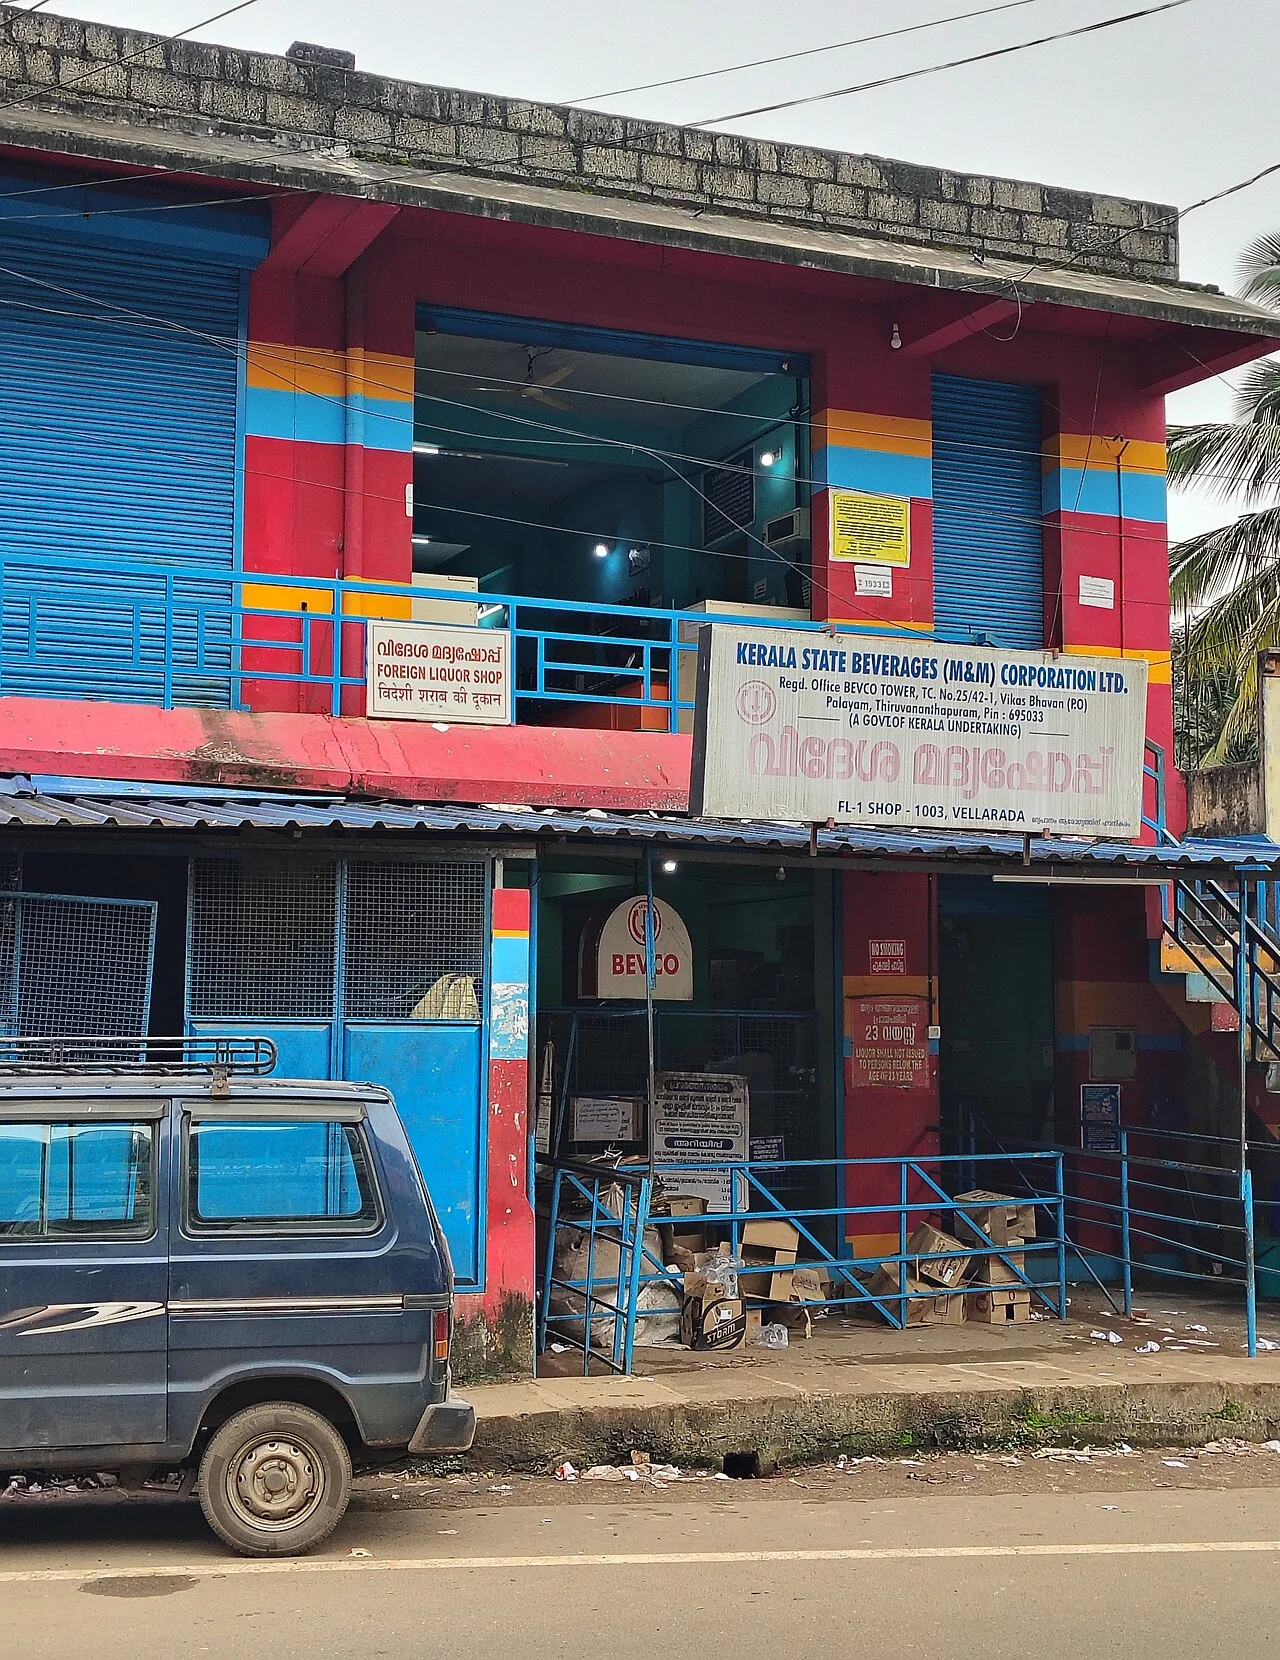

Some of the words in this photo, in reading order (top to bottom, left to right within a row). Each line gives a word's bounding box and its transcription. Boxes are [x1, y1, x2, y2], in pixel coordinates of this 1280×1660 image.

[377, 639, 429, 658] വിദേശ
[432, 645, 503, 664] മദ്യഷോപ്പ്
[377, 664, 426, 680] FOREIGN
[429, 666, 471, 683] LIQUOR
[473, 669, 503, 685] SHOP
[737, 642, 797, 669] KERALA
[802, 648, 847, 673] STATE
[851, 652, 938, 680] BEVERAGES
[943, 659, 996, 687] (M&M)
[1000, 664, 1097, 692] CORPORATION
[1099, 672, 1129, 694] LTD.
[378, 682, 414, 701] विदेशी
[418, 688, 448, 703] शराब
[453, 686, 468, 704] की
[471, 692, 503, 711] दूकान
[779, 676, 807, 693] Regd.
[811, 678, 841, 693] Office
[844, 681, 878, 695] BEVCO
[881, 683, 918, 700] TOWER,
[921, 687, 937, 700] TC.
[1000, 693, 1026, 706] Vikas
[1029, 694, 1064, 709] Bhavan
[826, 696, 873, 712] Palayam,
[875, 699, 981, 719] Thiruvananthapuram,
[984, 708, 999, 720] Pin
[1009, 710, 1044, 723] 695033
[849, 713, 860, 728] (A
[908, 717, 945, 732] KERALA
[948, 720, 1022, 739] UNDERTAKING)
[750, 725, 901, 783] വിദേശ
[912, 743, 1115, 800] മദ്യഷോപ്പ്
[838, 800, 862, 814] FL-1
[868, 802, 901, 816] SHOP
[914, 804, 948, 821] 1003,
[951, 806, 1025, 823] VELLARADA
[871, 943, 880, 956] NO
[880, 943, 904, 956] SMOKING
[865, 1025, 879, 1041] 23
[859, 1059, 867, 1069] TO
[912, 1060, 922, 1070] THE
[876, 1048, 893, 1058] SHALL
[894, 1048, 905, 1058] NOT
[906, 1048, 925, 1059] ISSUED
[896, 1071, 913, 1082] YEARS
[706, 1323, 736, 1344] STORM
